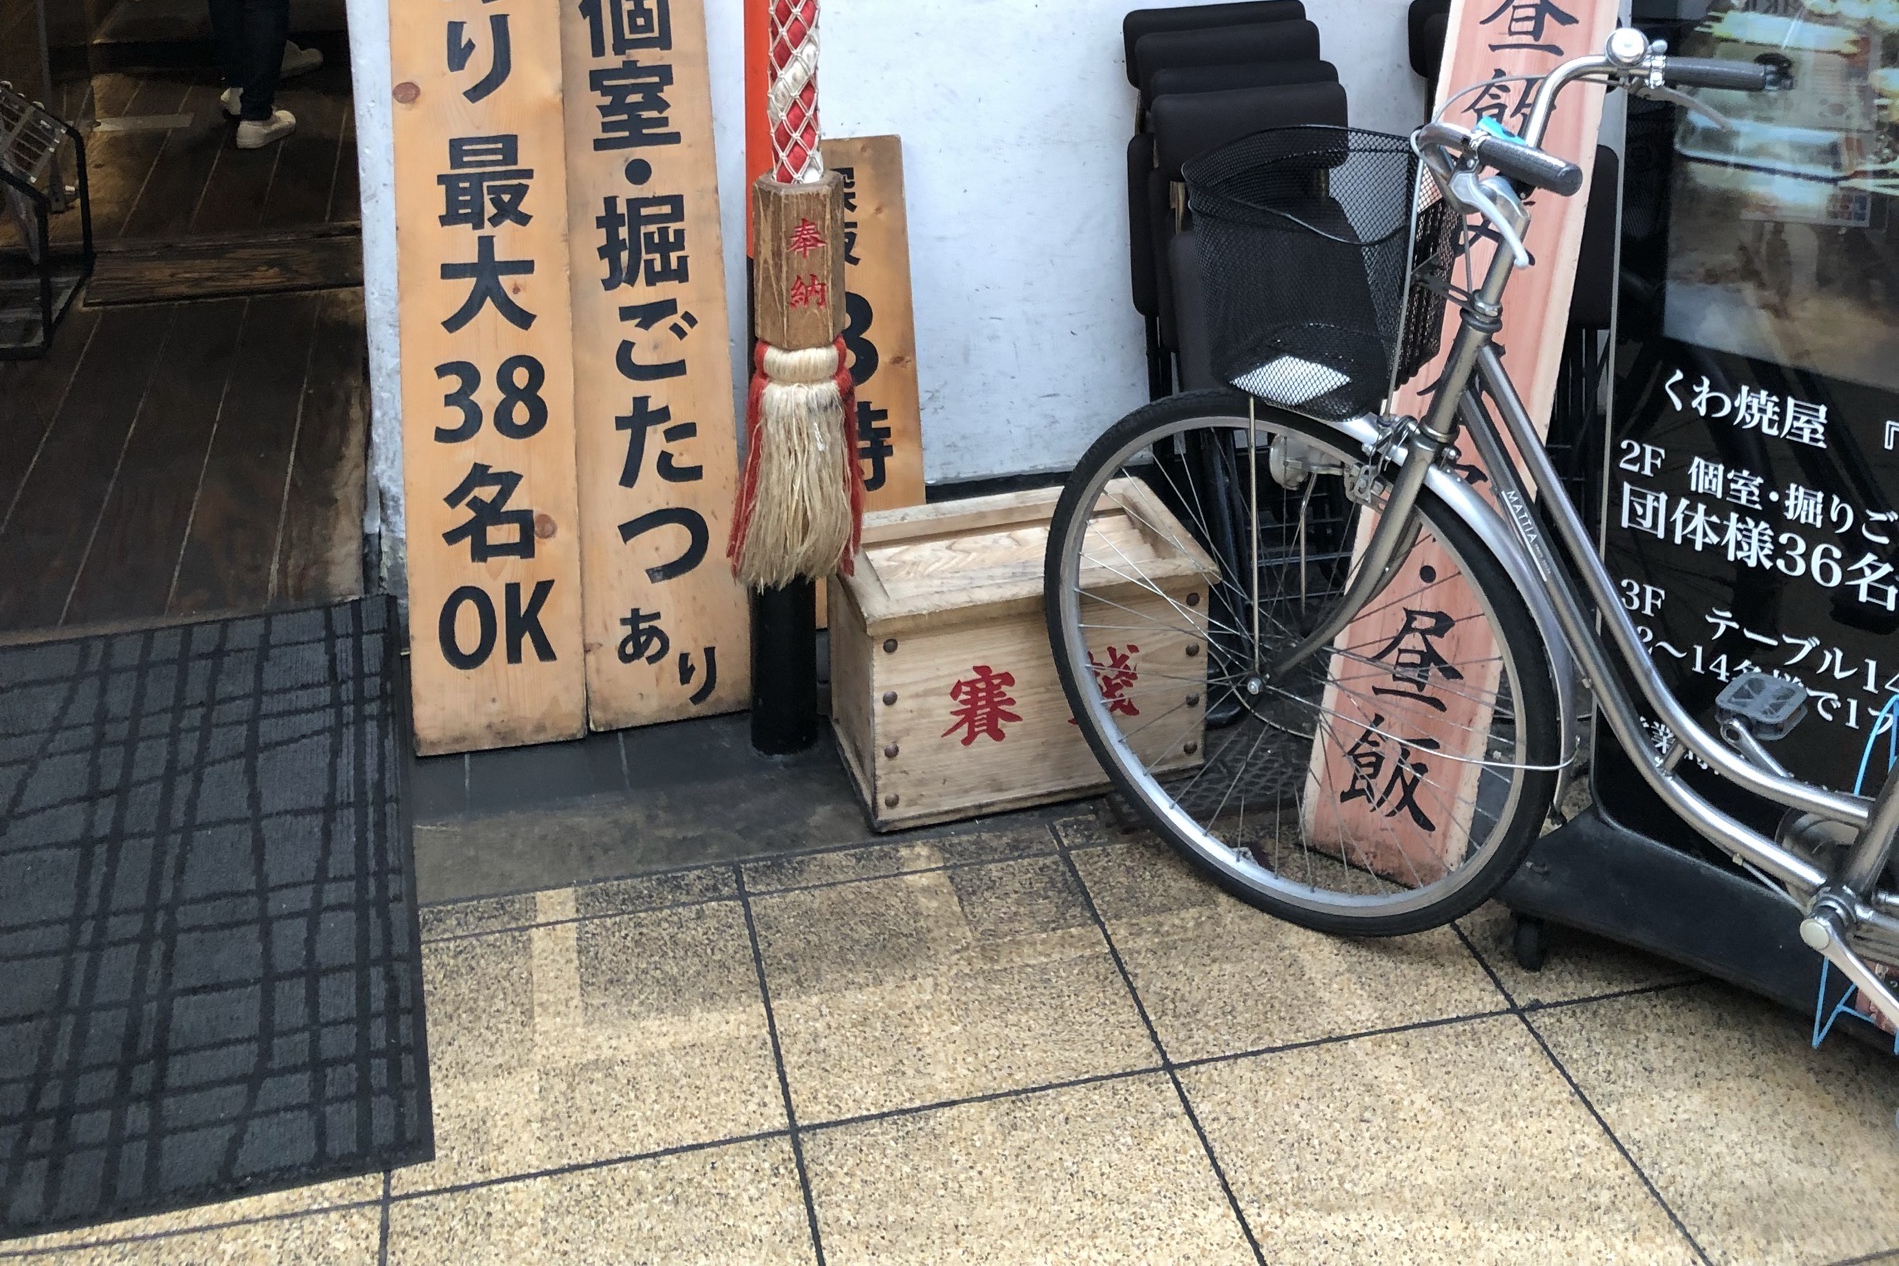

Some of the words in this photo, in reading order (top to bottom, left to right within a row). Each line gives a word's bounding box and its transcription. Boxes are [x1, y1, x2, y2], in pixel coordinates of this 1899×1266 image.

[788, 218, 828, 310] 奉納
[1664, 368, 1829, 450] くわ焼屋
[1618, 439, 1666, 478] 2F
[1506, 490, 1538, 543] MATTIA
[1620, 481, 1899, 612] 団体様36名
[1620, 578, 1666, 617] 3F
